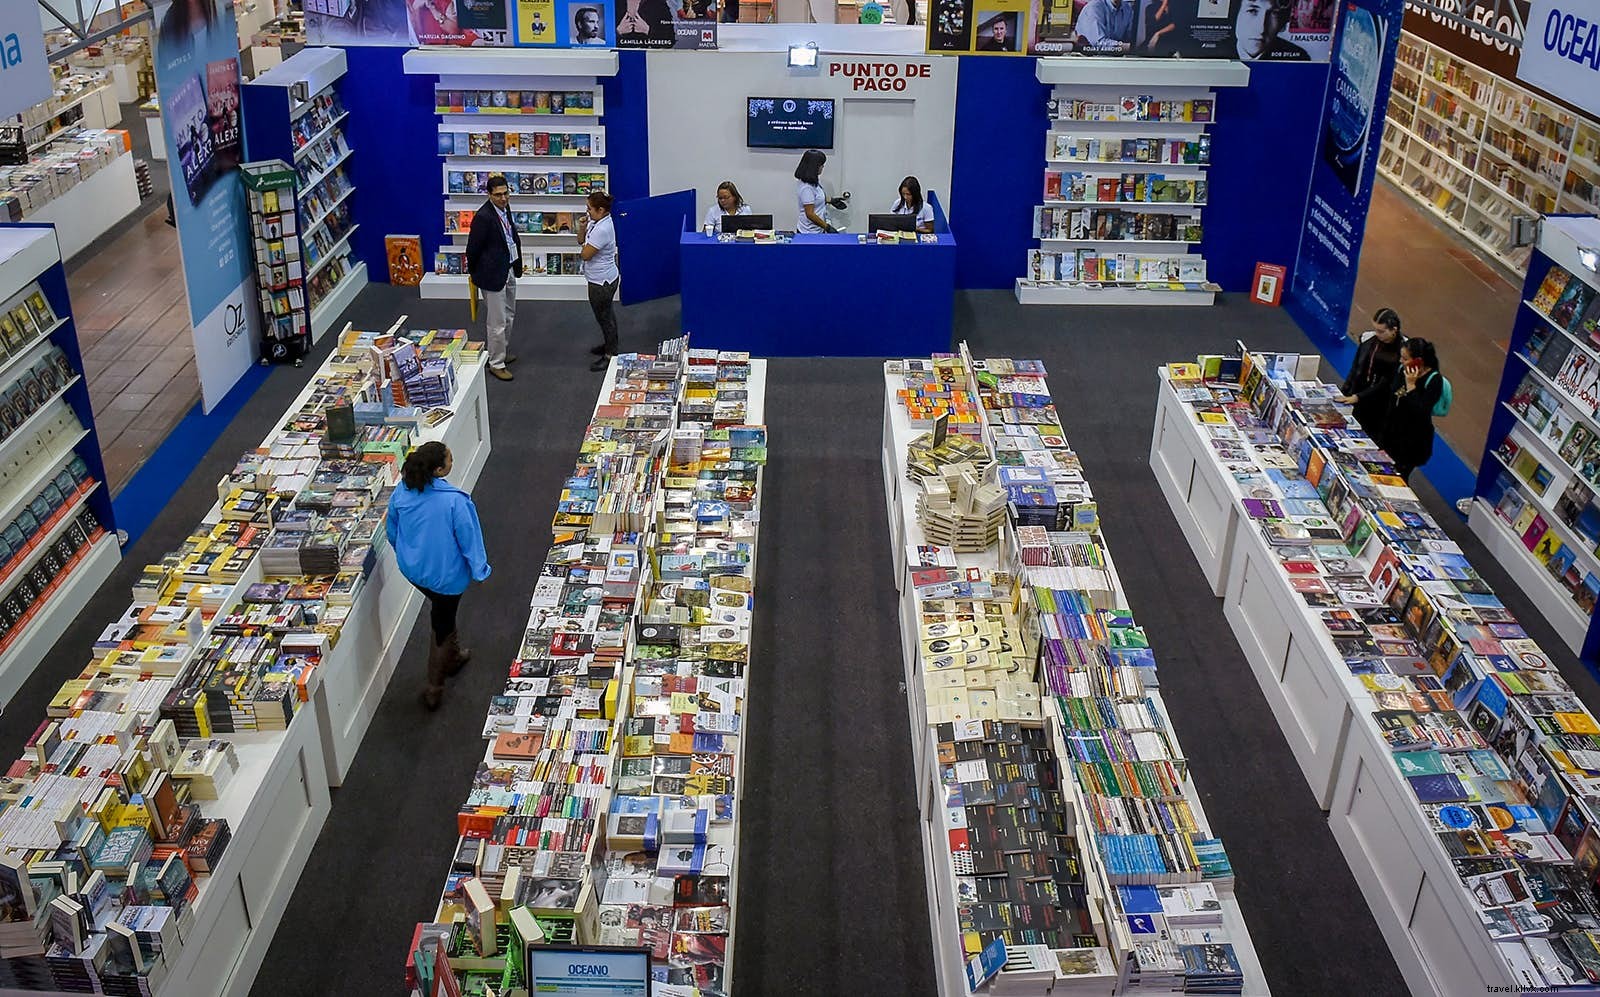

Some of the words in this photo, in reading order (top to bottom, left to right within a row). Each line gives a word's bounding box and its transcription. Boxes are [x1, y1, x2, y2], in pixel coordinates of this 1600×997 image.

[1543, 8, 1600, 72] OCEA
[0, 32, 22, 69] a
[829, 62, 898, 78] PUNTO
[905, 63, 931, 78] DE
[853, 77, 907, 92] PAGO
[214, 127, 239, 145] ALEX?
[186, 139, 213, 179] ALEX?
[568, 964, 609, 976] OCEANO
